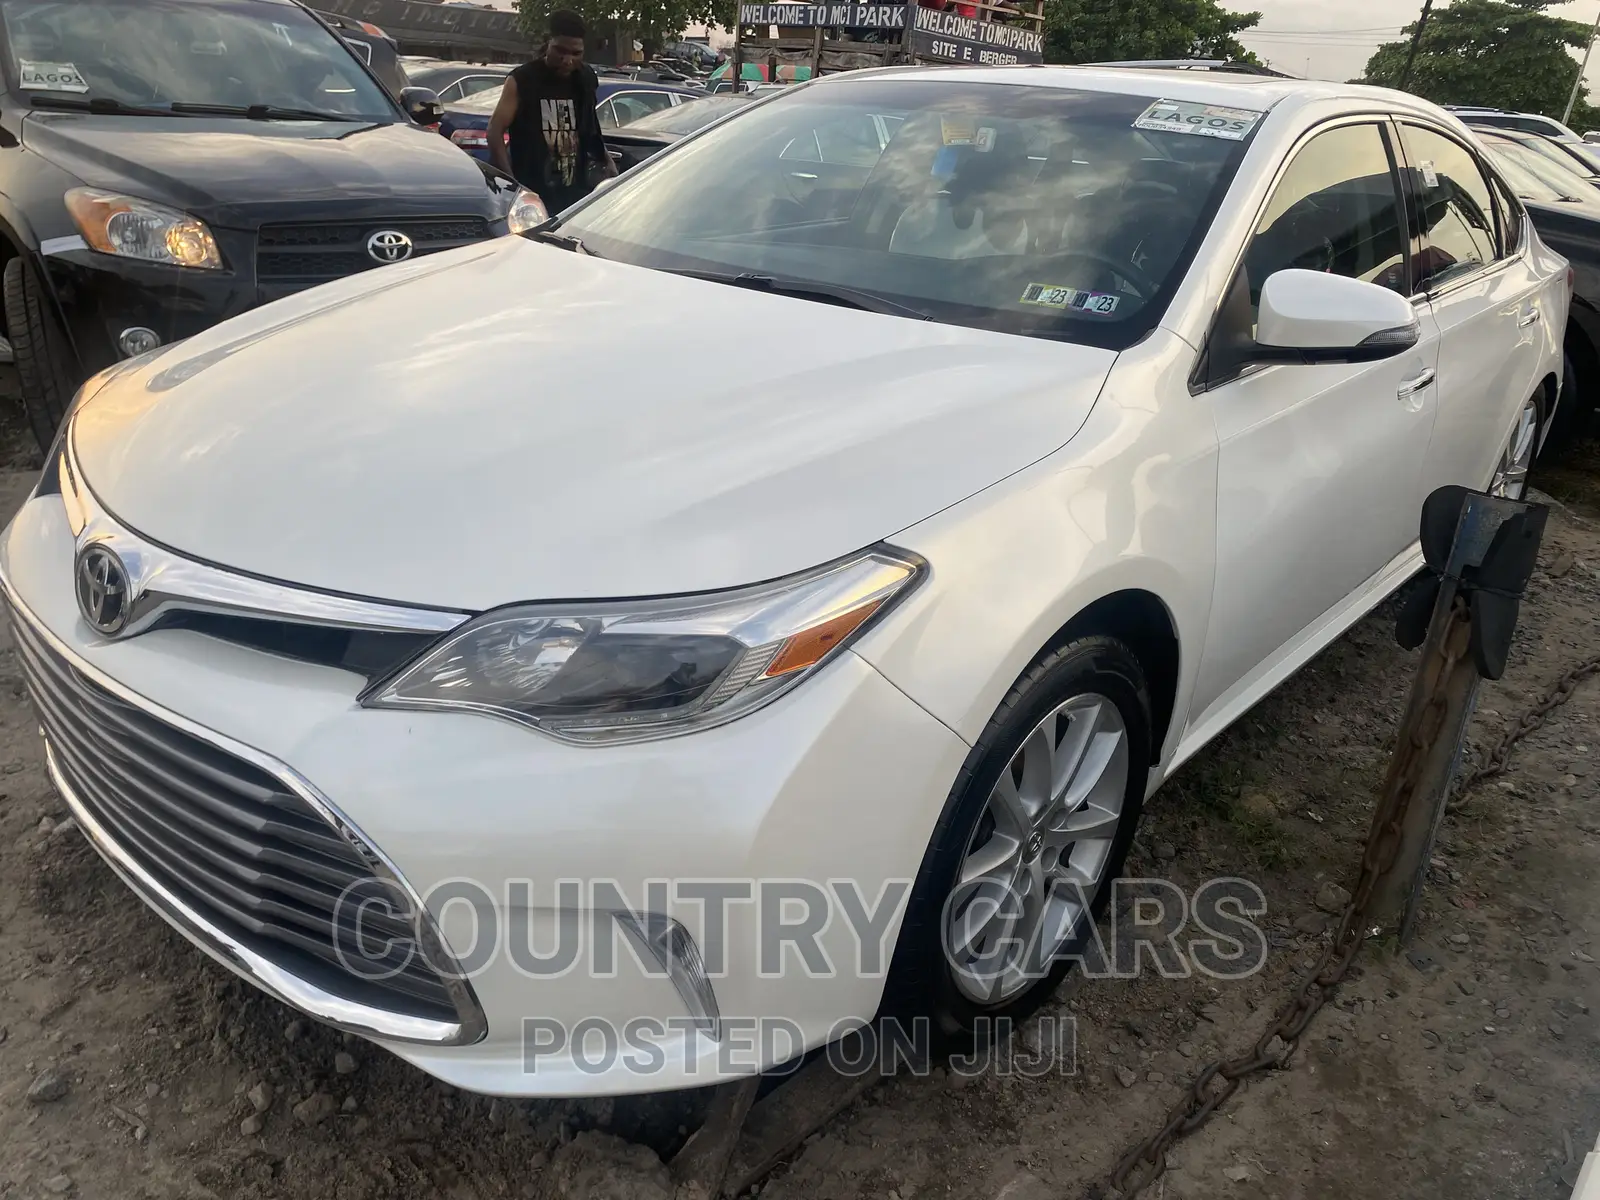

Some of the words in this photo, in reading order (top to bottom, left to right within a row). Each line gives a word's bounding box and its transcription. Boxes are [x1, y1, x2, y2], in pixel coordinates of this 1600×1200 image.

[740, 5, 804, 24] WELCOME
[807, 6, 827, 25] TO
[855, 6, 904, 27] PARK
[917, 8, 977, 40] WELCOME
[1009, 30, 1042, 53] PARK
[931, 41, 957, 58] SITE
[979, 50, 1018, 65] BERGER
[1147, 110, 1246, 131] LAGOS
[1049, 289, 1068, 305] 23
[1096, 296, 1115, 312] 23
